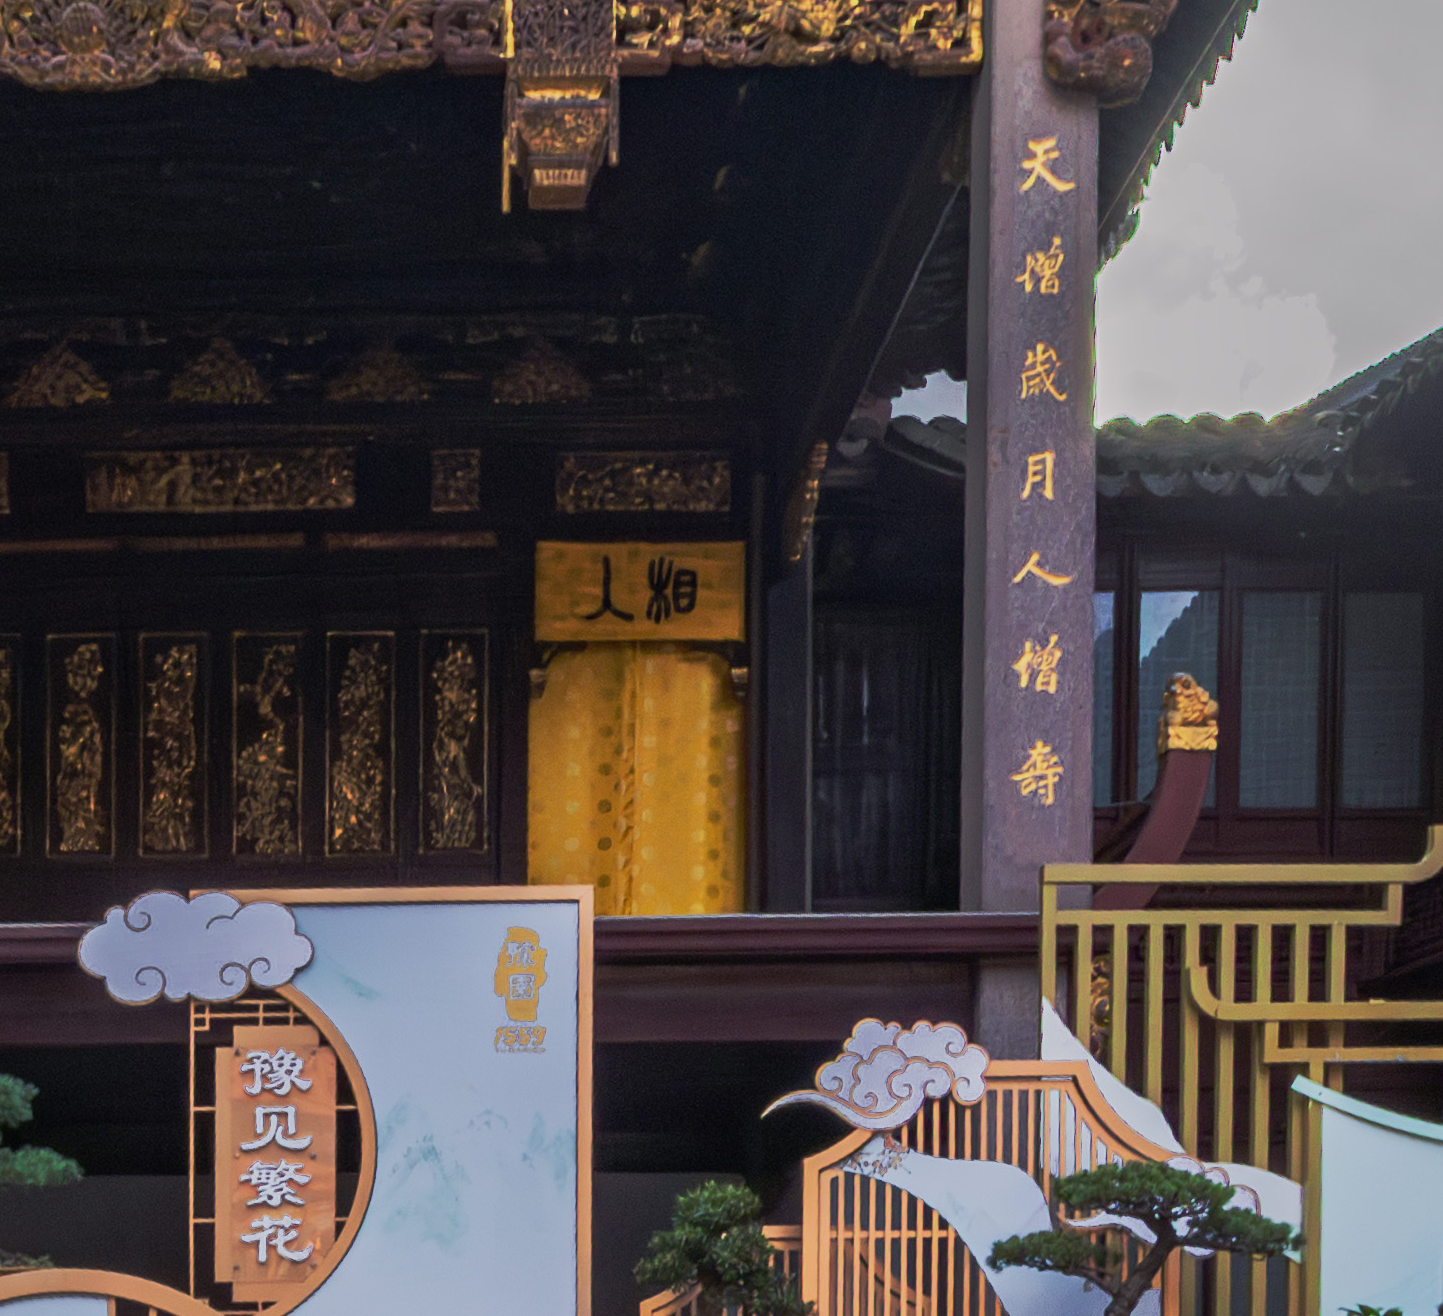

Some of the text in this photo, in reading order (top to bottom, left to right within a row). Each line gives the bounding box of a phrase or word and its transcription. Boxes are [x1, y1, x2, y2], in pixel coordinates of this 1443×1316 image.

[493, 1025, 547, 1046] 1559
[239, 1047, 314, 1264] 豫见繁花
